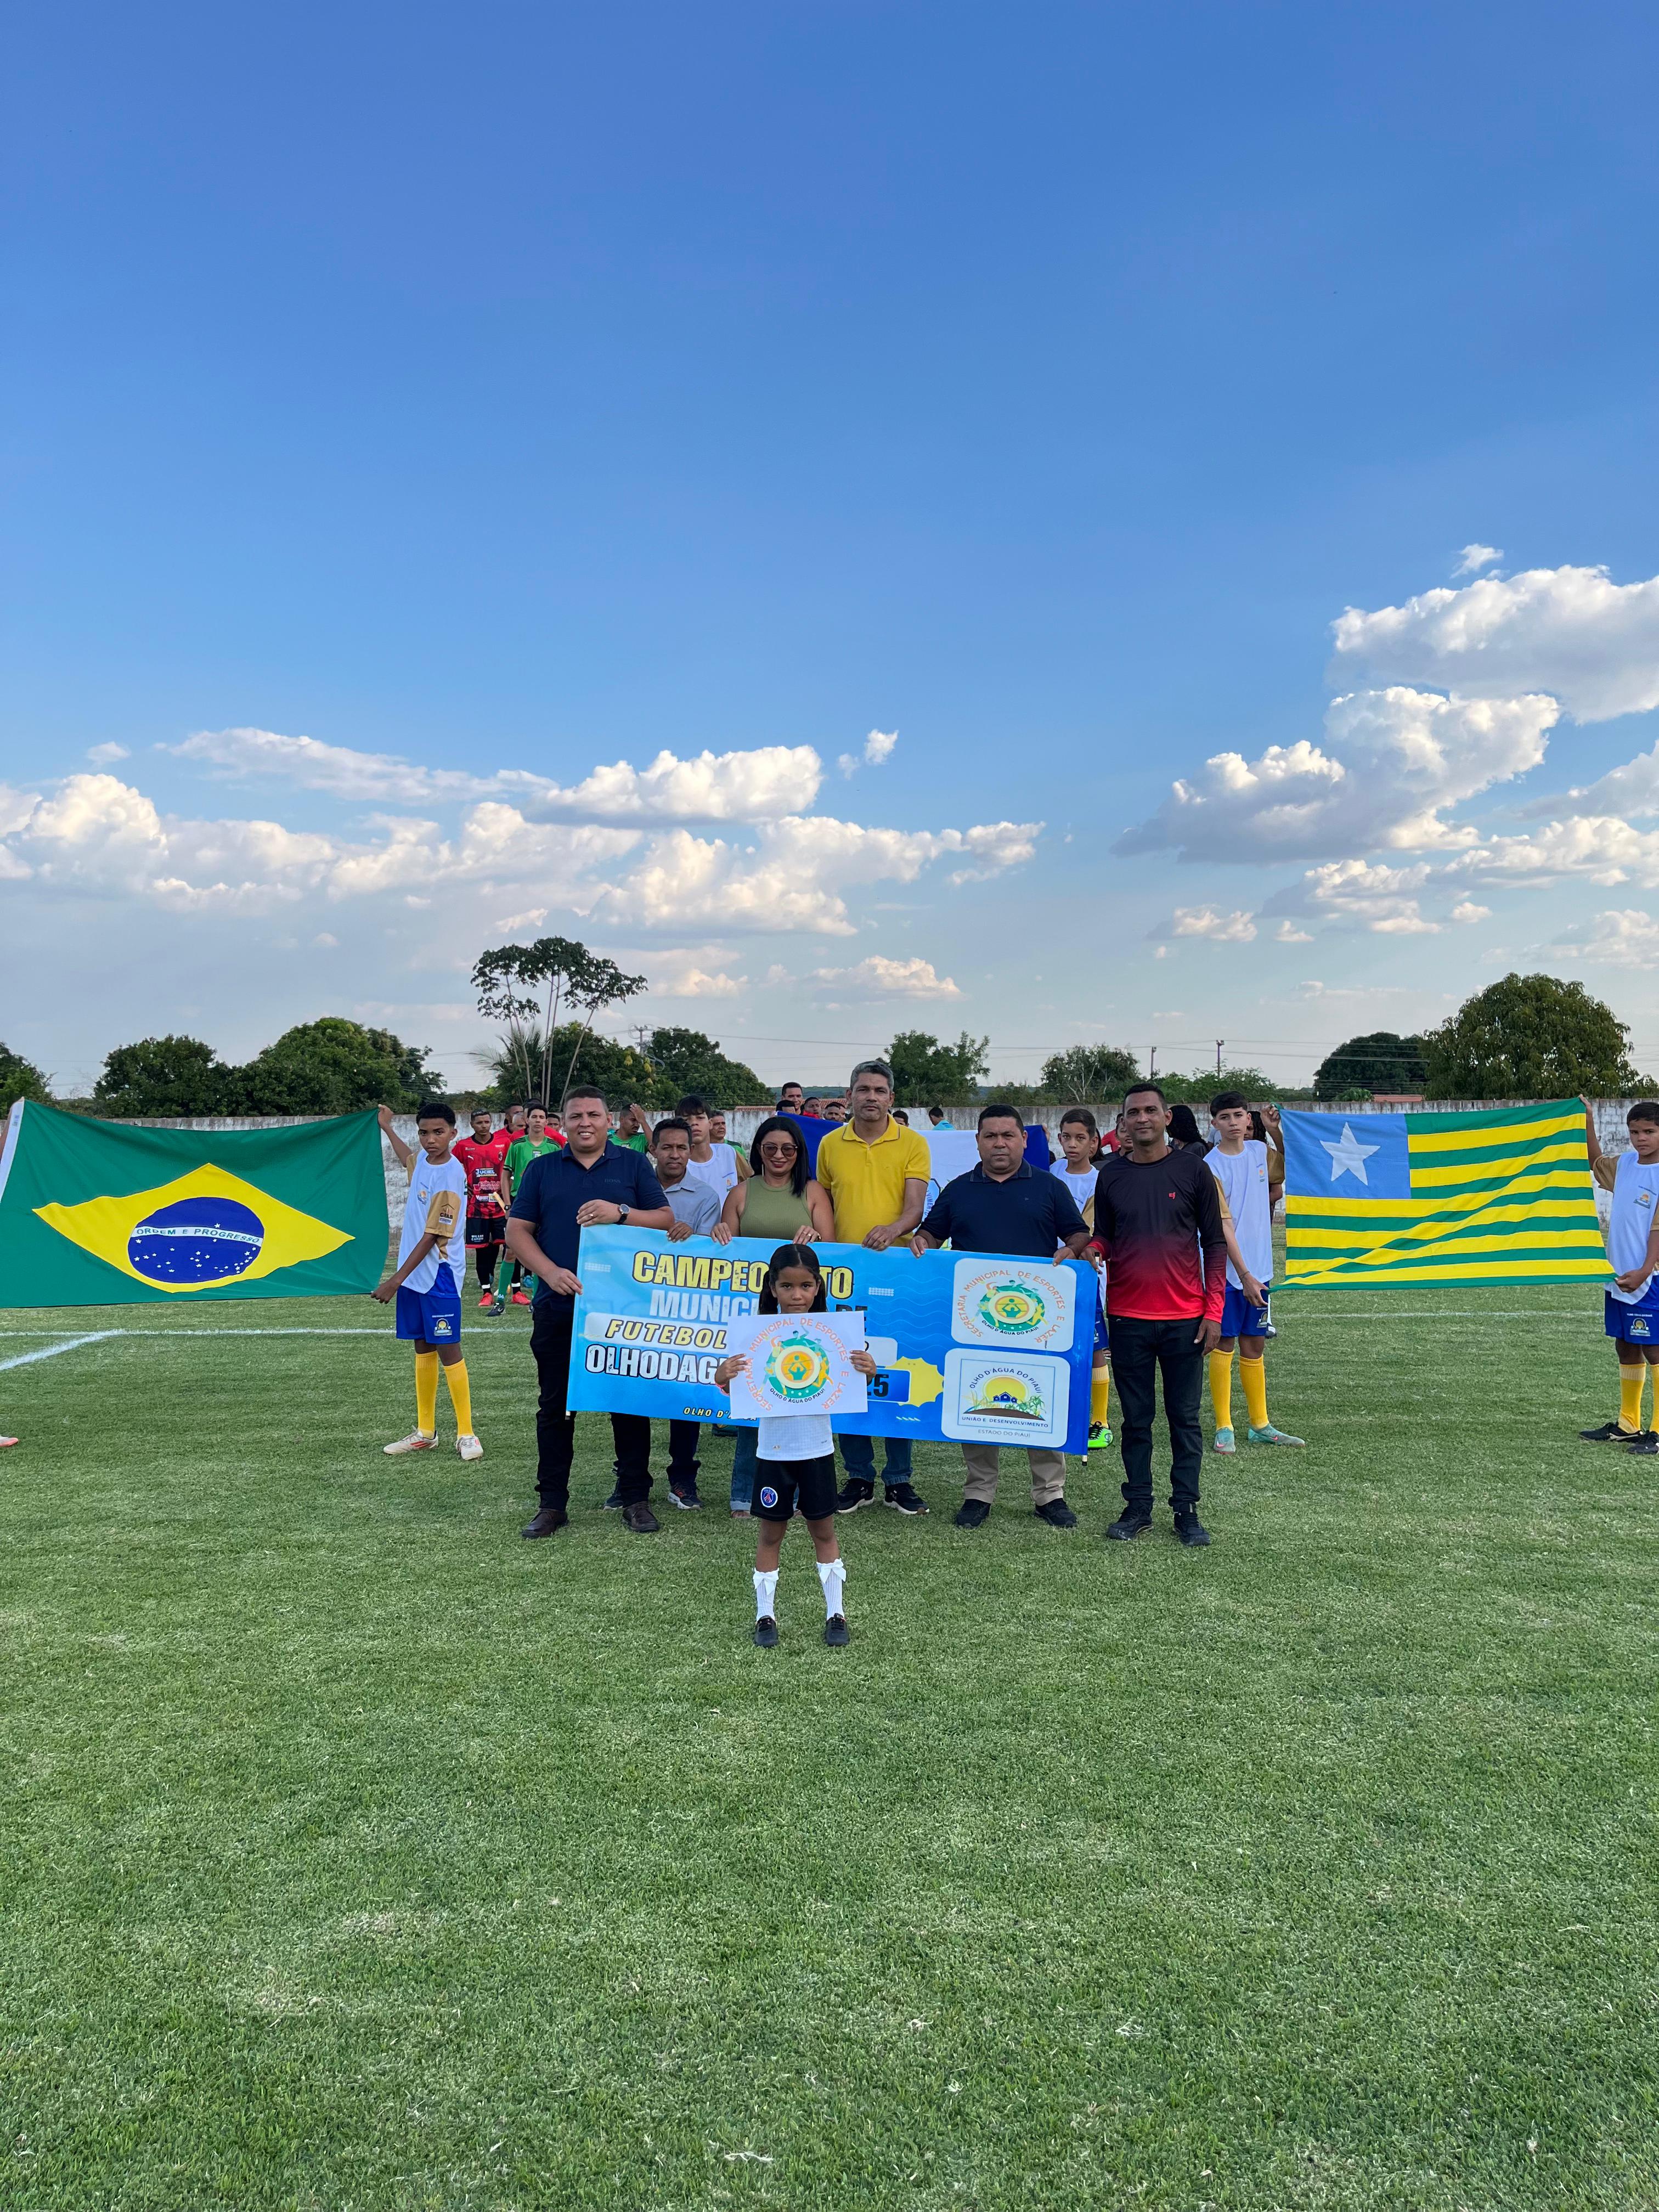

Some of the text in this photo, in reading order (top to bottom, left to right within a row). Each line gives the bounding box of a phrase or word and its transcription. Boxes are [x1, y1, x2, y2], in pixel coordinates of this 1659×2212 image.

[194, 1228, 259, 1243] PROGRESSO
[964, 1269, 1012, 1291] MUNICIPAL
[1018, 1271, 1031, 1279] DE
[1033, 1275, 1065, 1310] ESPORTES
[800, 1317, 813, 1327] DE
[957, 1295, 983, 1338] SECRETARIA
[982, 1320, 994, 1330] OLHO
[605, 1319, 727, 1349] FUTEBOL
[749, 1318, 794, 1352] MUNICIPAL
[815, 1322, 849, 1362] ESPORTES
[1035, 1324, 1060, 1343] LAZER
[969, 1373, 984, 1389] OLHO
[770, 1388, 782, 1399] OLHO
[821, 1382, 846, 1409] LAZER
[684, 1407, 712, 1417] OLHO
[989, 1419, 1048, 1428] DESENVOLVIMENTO
